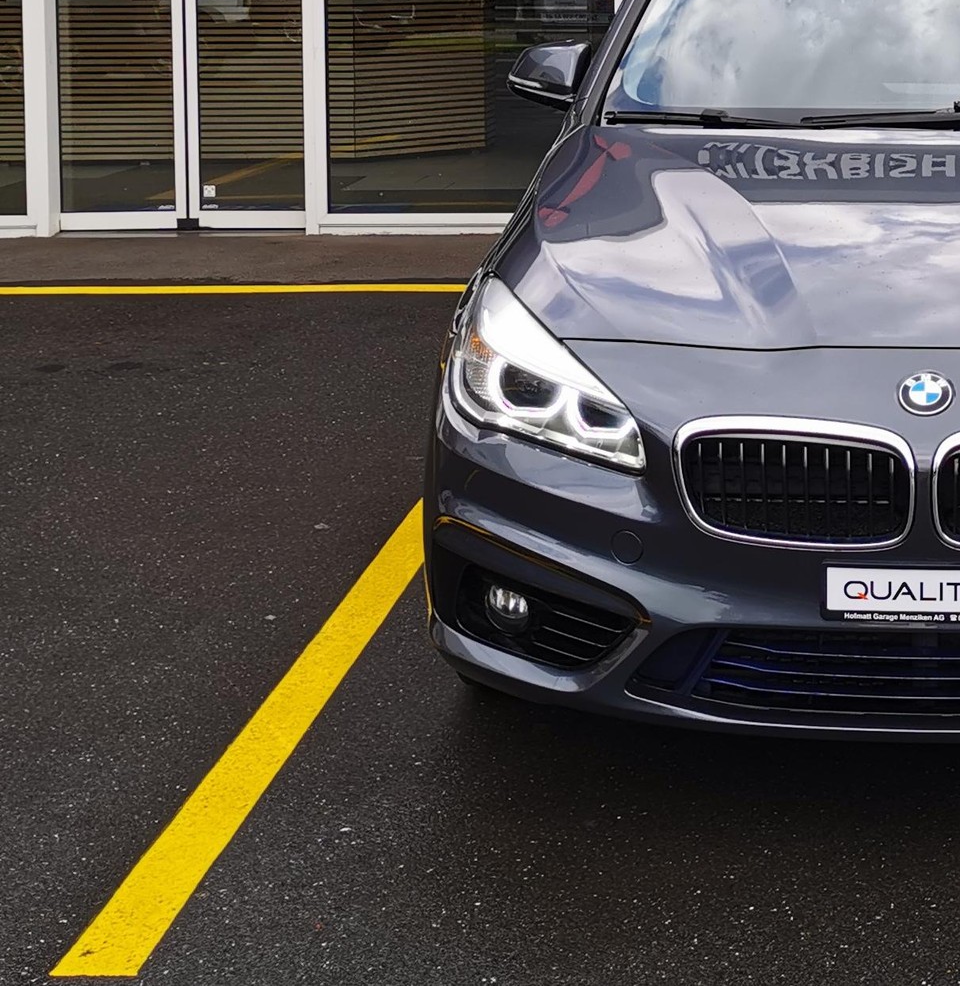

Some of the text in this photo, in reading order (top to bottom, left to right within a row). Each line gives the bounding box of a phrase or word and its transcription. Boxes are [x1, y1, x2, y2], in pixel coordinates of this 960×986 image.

[844, 612, 872, 620] Hofmatt
[873, 612, 898, 622] Garage
[899, 613, 933, 622] Menziken
